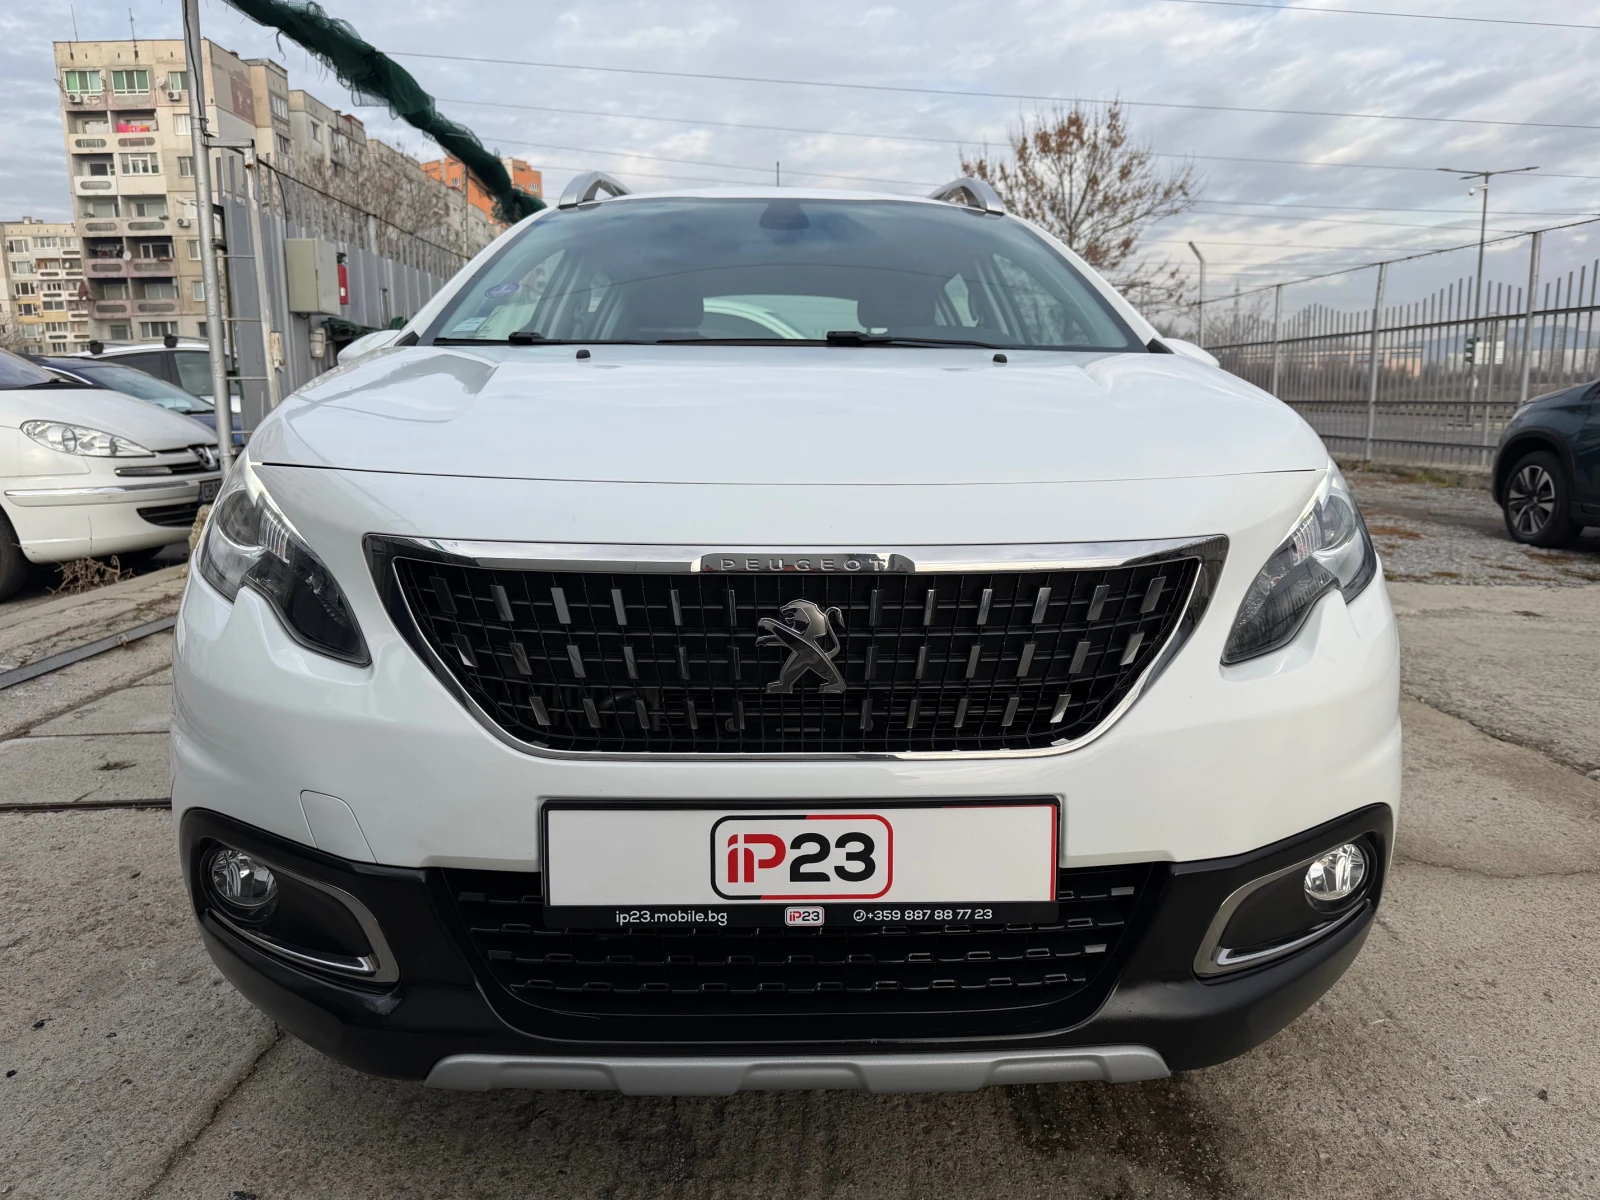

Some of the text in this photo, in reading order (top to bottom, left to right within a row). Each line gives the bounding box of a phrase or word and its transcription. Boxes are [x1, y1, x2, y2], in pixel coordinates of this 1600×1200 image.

[719, 557, 887, 572] PEUGEOT
[615, 909, 728, 926] ip23.mobile.bg
[867, 908, 993, 921] +359 887 88 77 23
